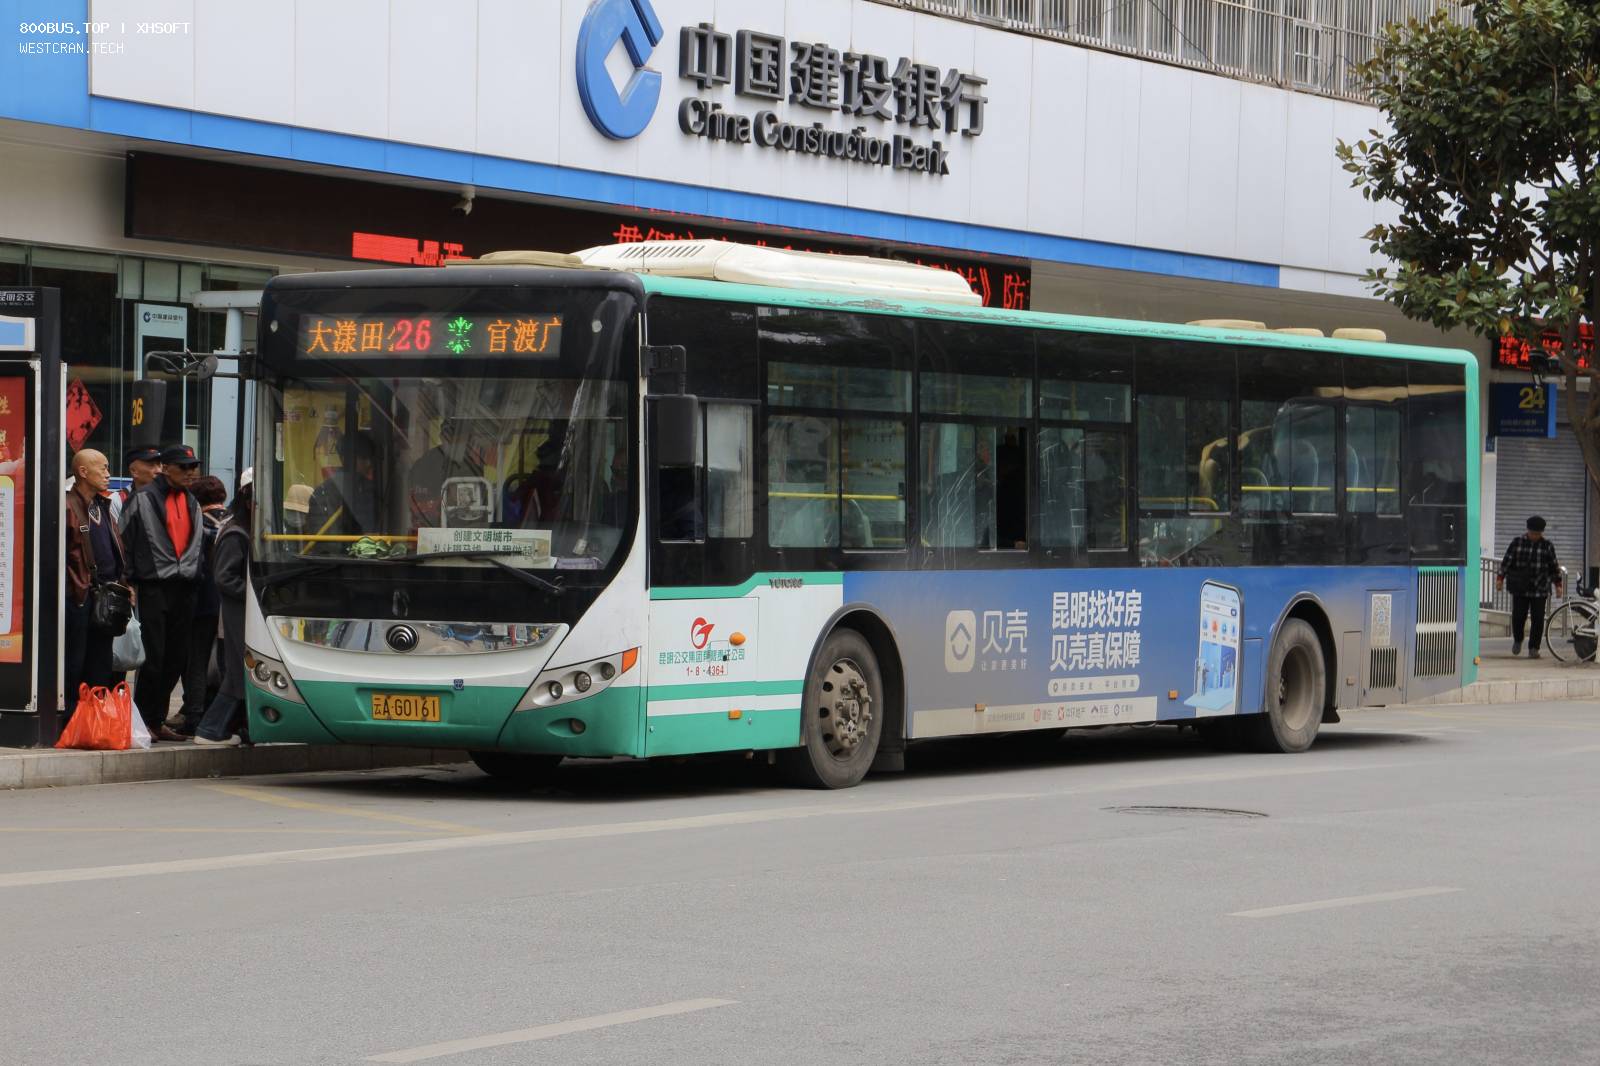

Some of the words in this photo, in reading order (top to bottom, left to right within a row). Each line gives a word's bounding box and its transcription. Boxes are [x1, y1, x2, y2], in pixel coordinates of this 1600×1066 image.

[679, 22, 989, 137] 中国建设银行
[678, 96, 751, 143] China
[753, 110, 891, 166] Construction
[893, 134, 950, 176] Bank
[394, 319, 431, 351] 26
[131, 398, 143, 426] 26
[1519, 387, 1545, 409] 24
[453, 530, 513, 543] 创建文明城市
[1051, 589, 1142, 630] 昆明找好房
[981, 608, 1029, 655] 贝壳
[1050, 630, 1141, 673] 贝壳真保障
